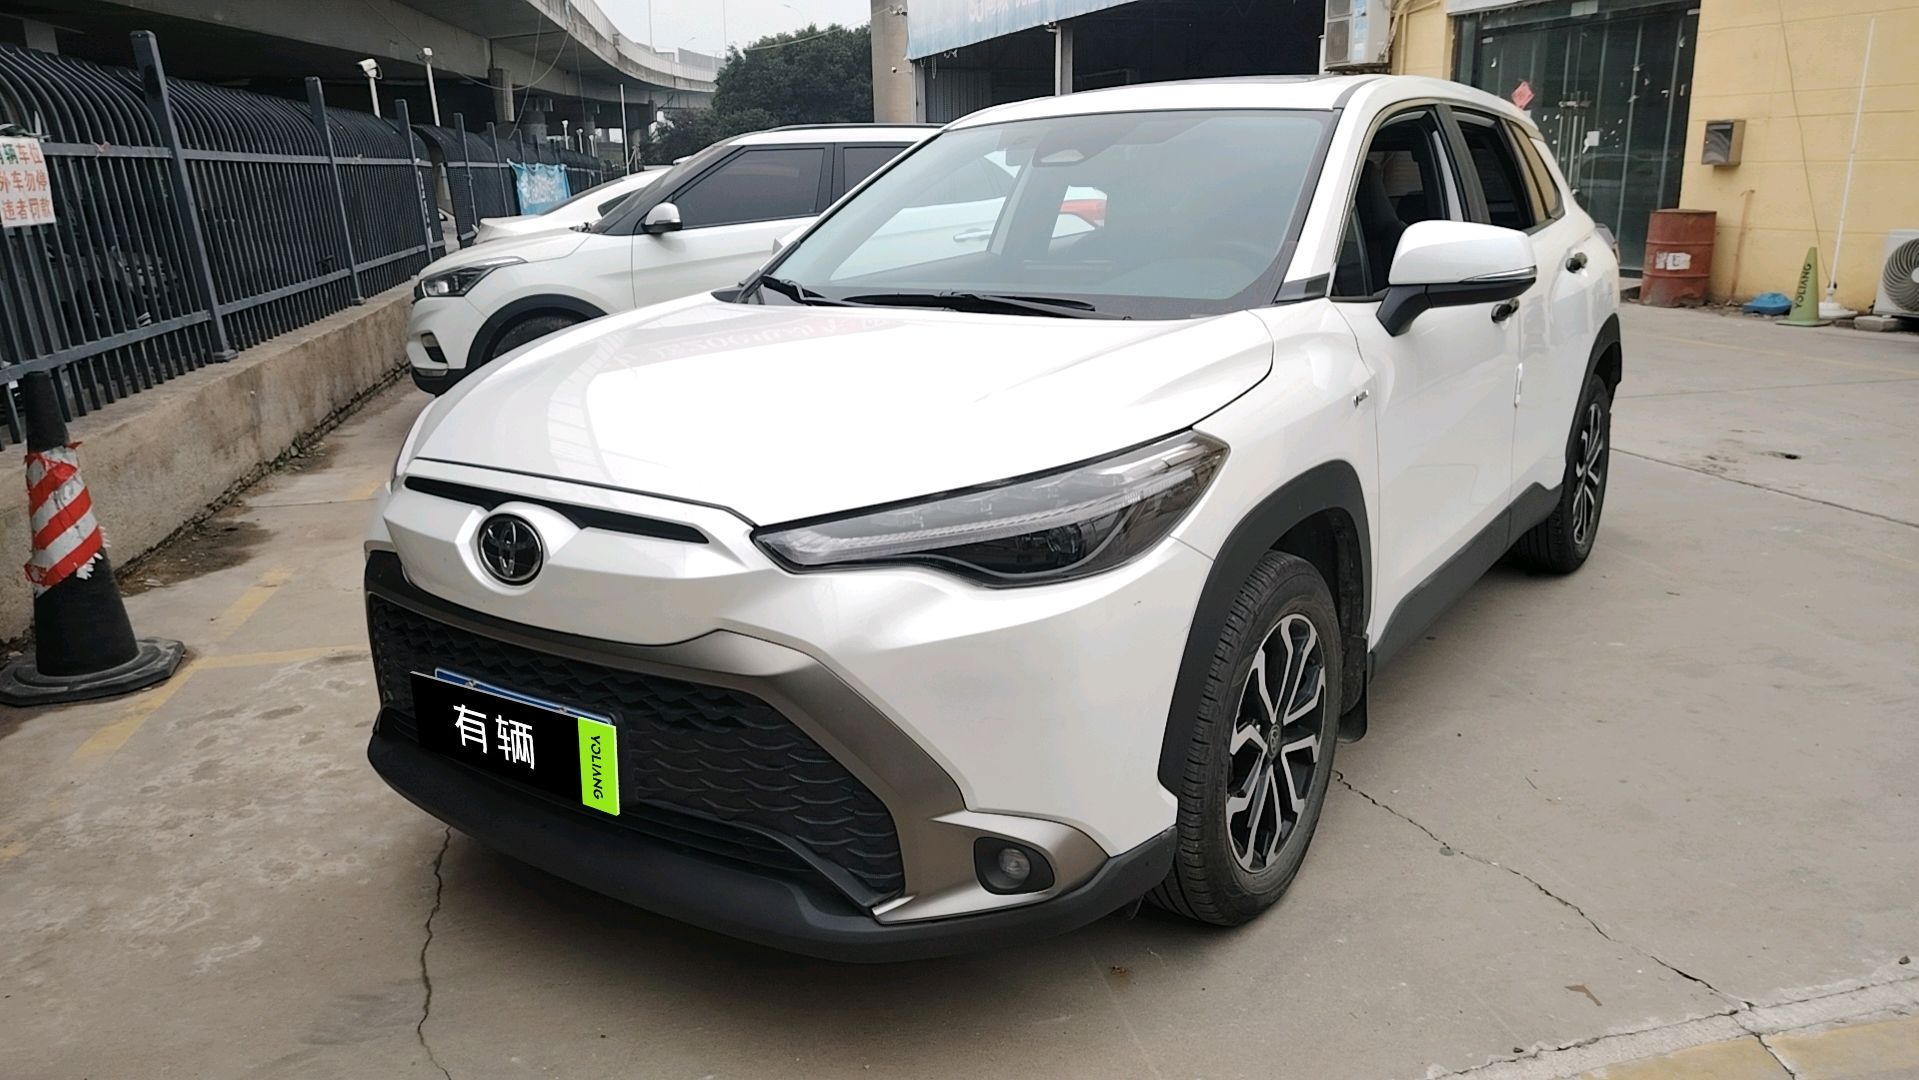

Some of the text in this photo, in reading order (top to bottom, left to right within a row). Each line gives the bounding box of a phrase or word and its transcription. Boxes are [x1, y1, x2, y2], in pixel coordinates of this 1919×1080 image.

[0, 143, 43, 164] 辆车位
[3, 197, 50, 220] 违者罚款
[1795, 263, 1812, 309] YOLIANG
